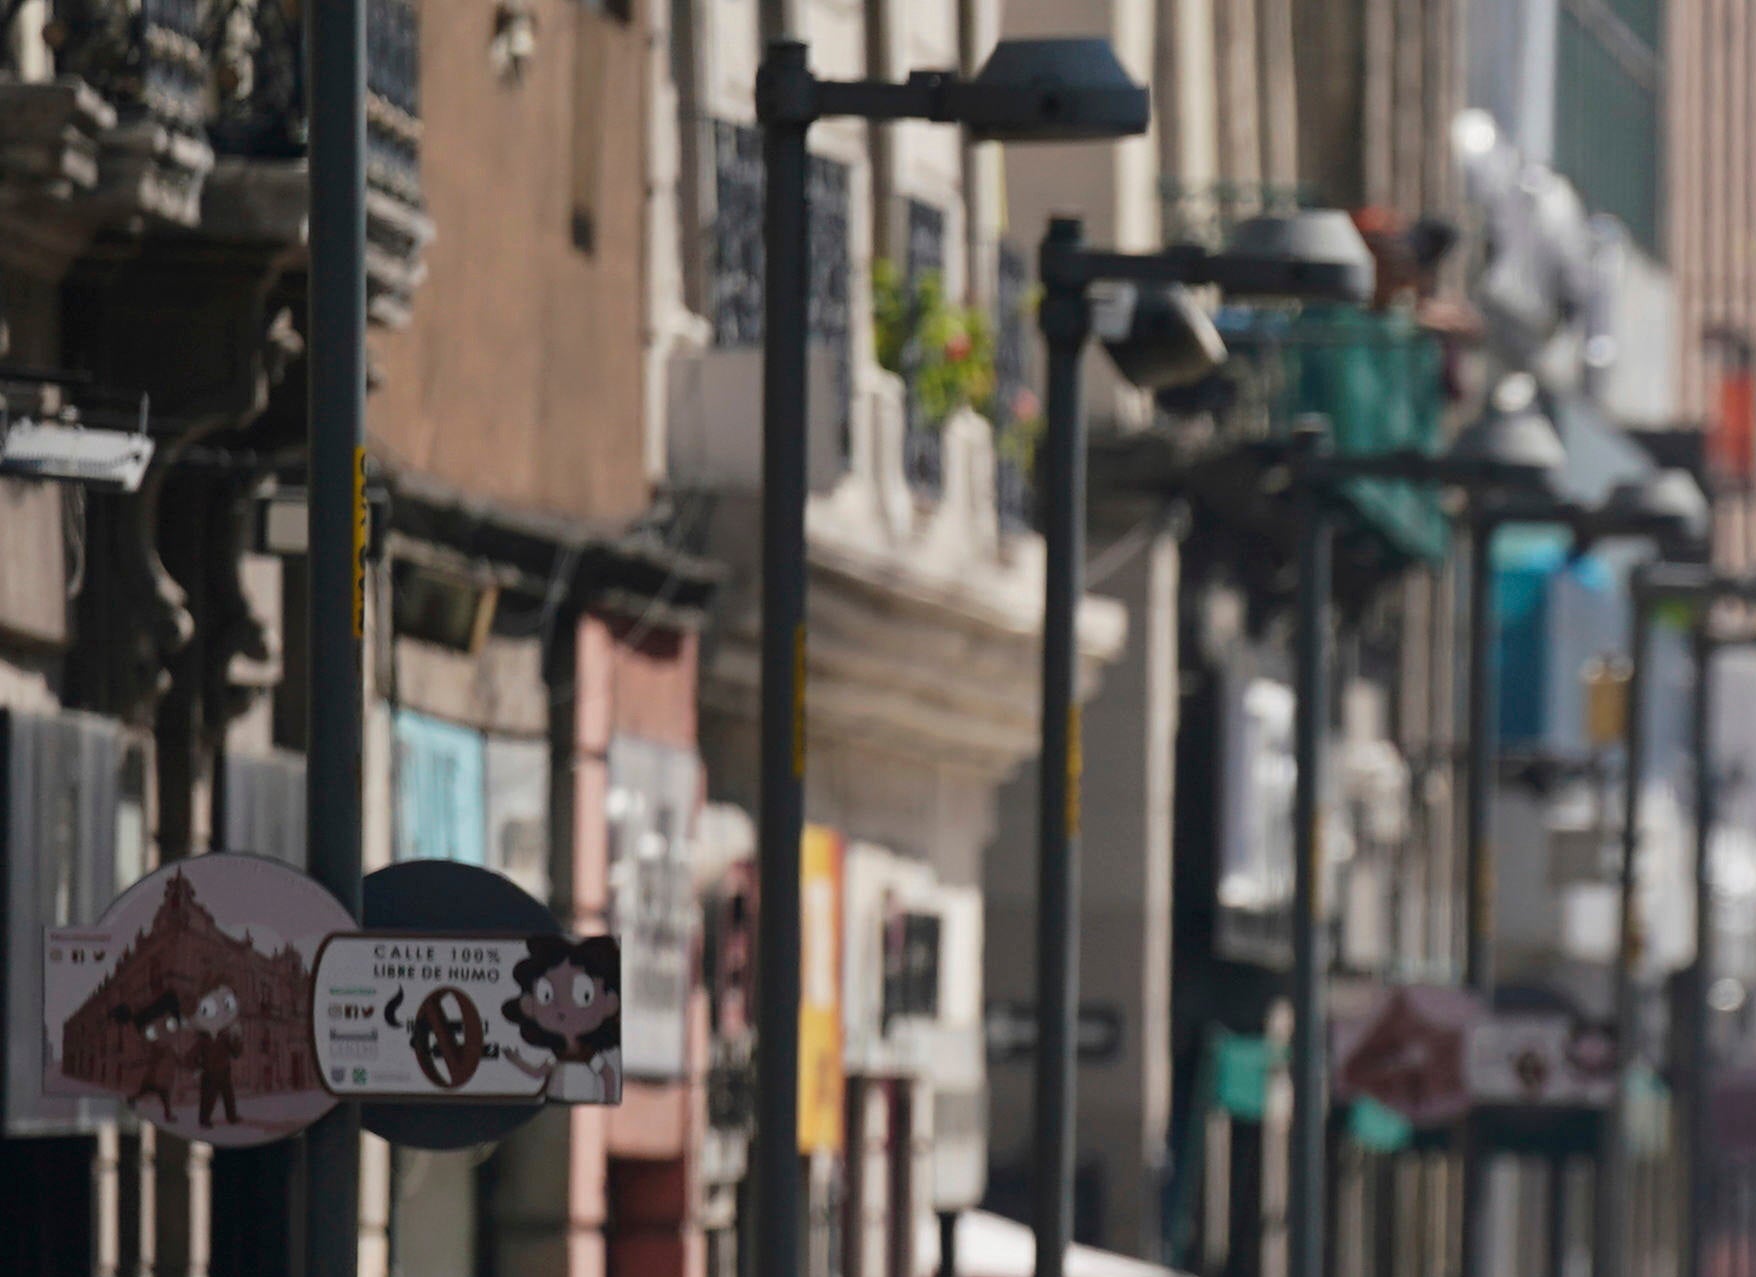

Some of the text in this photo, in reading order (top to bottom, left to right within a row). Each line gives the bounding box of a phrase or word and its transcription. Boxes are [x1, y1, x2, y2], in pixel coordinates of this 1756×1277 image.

[374, 945, 500, 963] CALLE 100%
[374, 966, 500, 982] LIBRE DE HUMO
